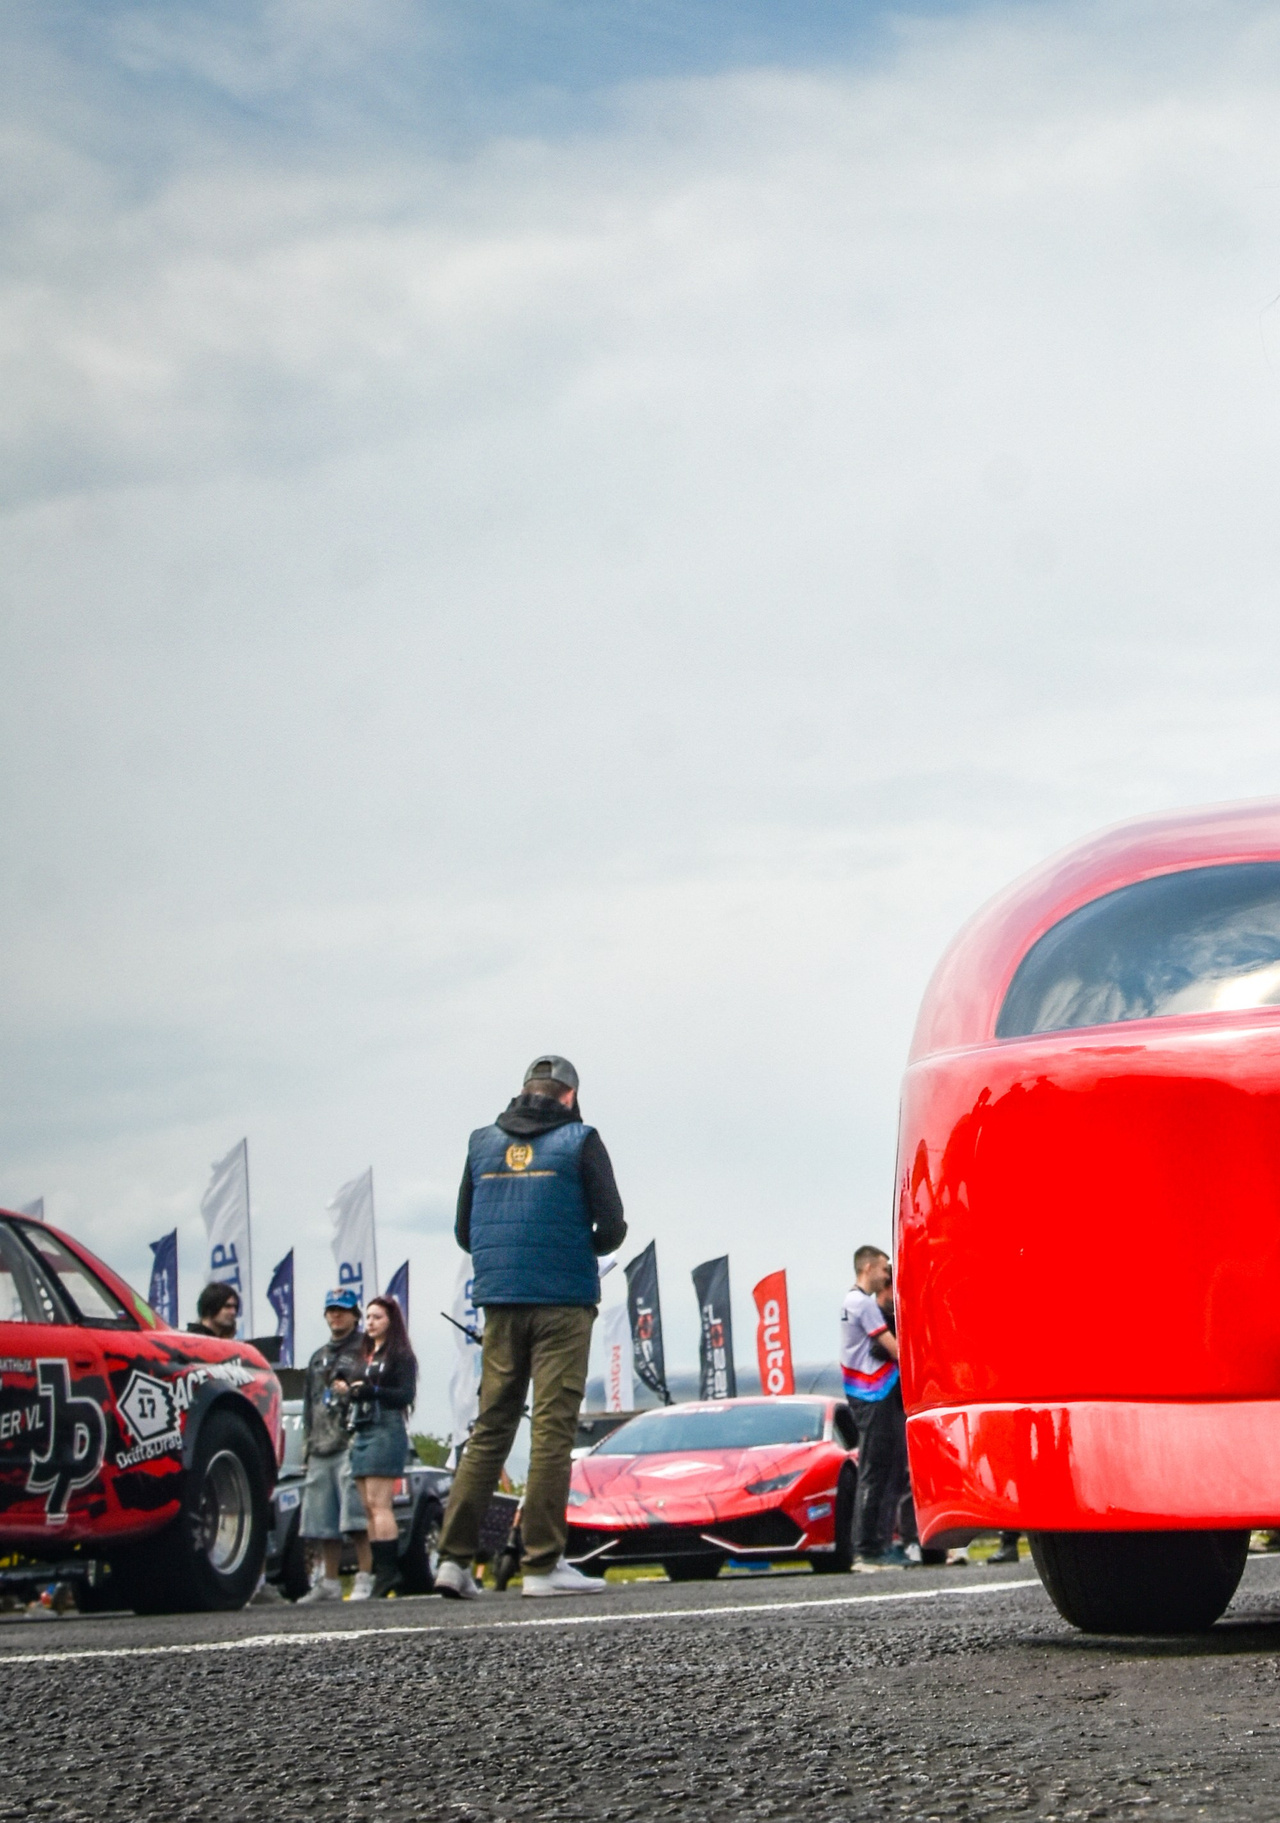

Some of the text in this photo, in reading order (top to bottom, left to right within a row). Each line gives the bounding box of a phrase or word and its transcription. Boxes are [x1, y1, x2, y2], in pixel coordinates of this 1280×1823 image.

[763, 1299, 785, 1395] auto
[25, 1404, 44, 1431] VL
[138, 1398, 156, 1419] 17
